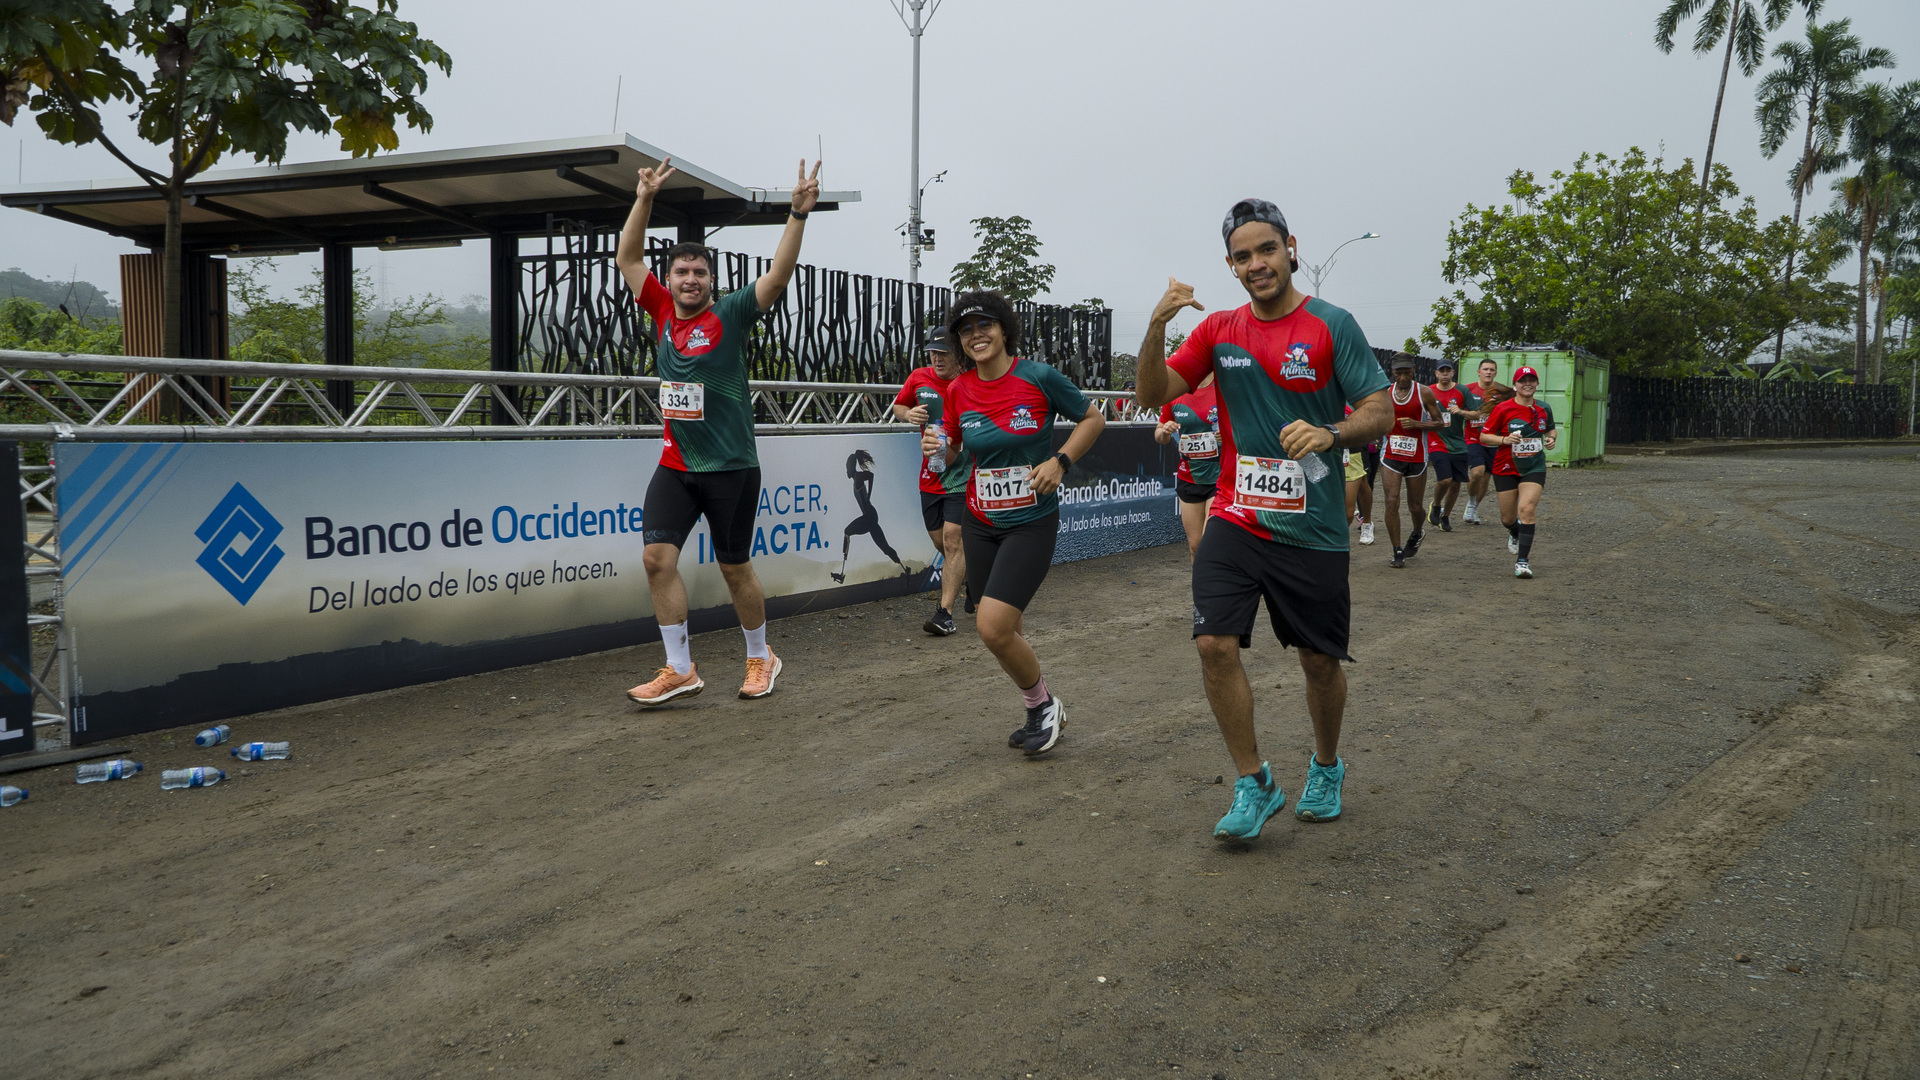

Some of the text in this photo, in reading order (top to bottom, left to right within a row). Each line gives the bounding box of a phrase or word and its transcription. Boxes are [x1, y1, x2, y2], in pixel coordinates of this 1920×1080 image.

[667, 393, 690, 409] 334
[1187, 441, 1207, 452] 251
[1393, 441, 1413, 451] 1435
[1519, 444, 1536, 452] 343
[985, 479, 1023, 498] 1017
[1057, 482, 1092, 506] Banco
[1094, 479, 1109, 500] de
[1109, 476, 1161, 501] Occidente
[1244, 472, 1294, 496] 1484
[757, 484, 829, 516] ACER,
[305, 501, 644, 560] Banco de Occidente
[1057, 509, 1152, 534] Del lado de los que hacen.
[309, 559, 618, 614] Del lado de los que hacen.
